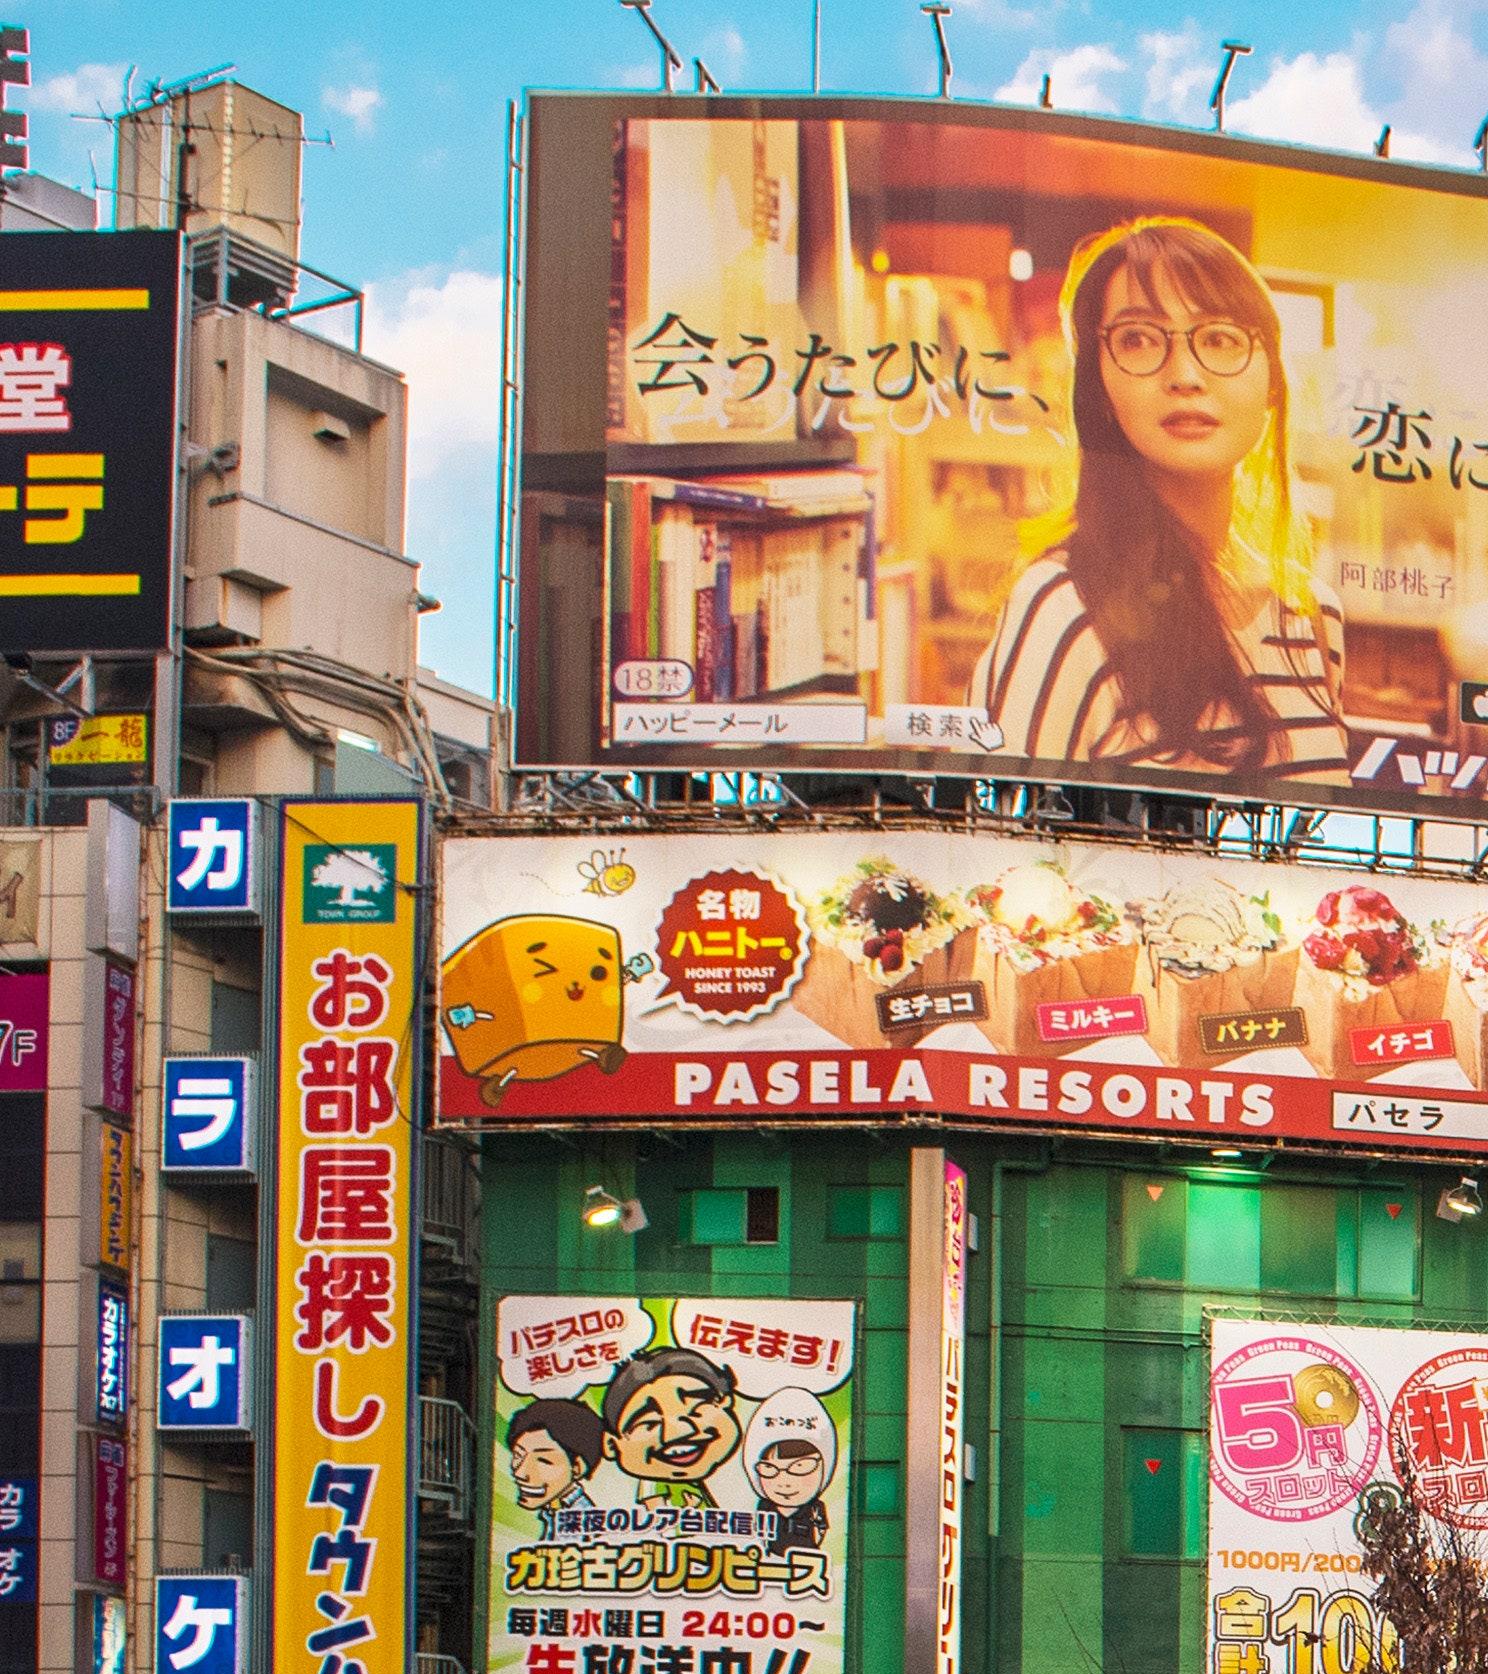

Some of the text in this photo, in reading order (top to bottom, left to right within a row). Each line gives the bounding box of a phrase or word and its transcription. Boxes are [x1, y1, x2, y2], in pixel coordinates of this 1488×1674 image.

[634, 312, 1049, 412] 会うたびに、
[1340, 561, 1456, 600] 阿部桃子
[621, 666, 685, 692] 18禁
[623, 713, 788, 735] ハッピーメール
[907, 712, 964, 737] 検索
[178, 817, 243, 891] カ
[696, 889, 761, 921] 名物
[685, 966, 776, 980] HONEY TOAST
[695, 982, 766, 994] SINCE 1993
[889, 992, 974, 1021] 生チョコ
[1050, 1007, 1134, 1031] ミルキー
[1217, 1018, 1286, 1042] バナナ
[1368, 1030, 1434, 1055] イチゴ
[675, 1061, 1274, 1126] PASELA RESORTS
[172, 1079, 232, 1151] ラ
[1349, 1101, 1444, 1130] パセラ
[510, 1309, 624, 1355] パチスロの
[690, 1314, 842, 1370] 伝えます!
[167, 1335, 233, 1408] オ
[527, 1339, 621, 1381] 楽しさを
[1247, 1465, 1345, 1504] スロット
[163, 1594, 232, 1670] ケ
[507, 1609, 664, 1639] 毎週水曜日
